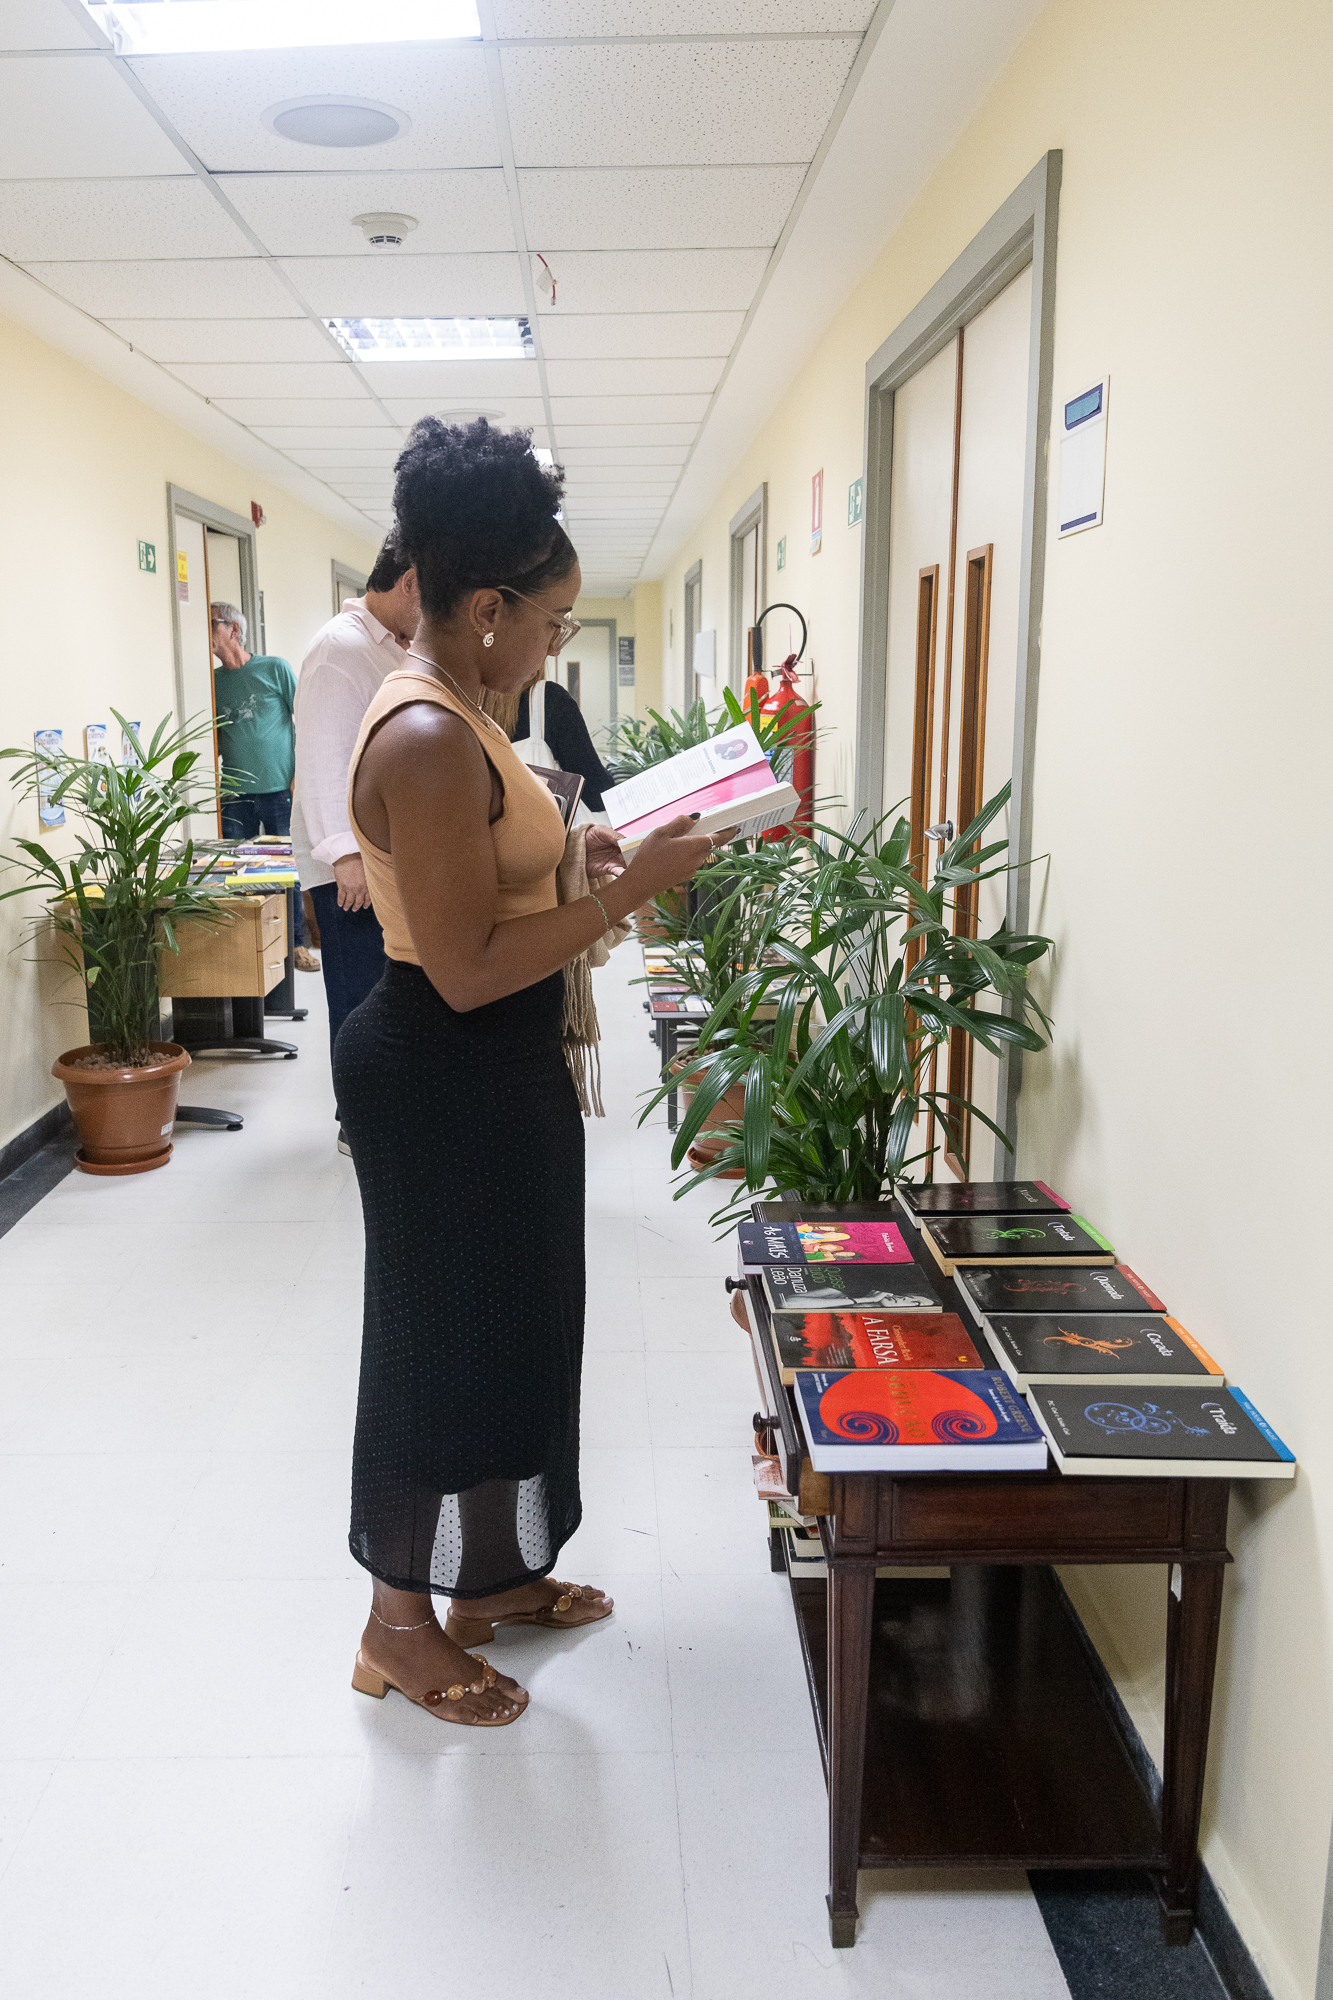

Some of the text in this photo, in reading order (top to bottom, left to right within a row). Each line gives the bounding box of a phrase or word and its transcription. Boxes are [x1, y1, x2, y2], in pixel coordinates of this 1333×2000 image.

[1053, 1224, 1076, 1242] Tentada
[765, 1237, 790, 1260] MAIS
[770, 1267, 788, 1286] Leão
[786, 1267, 808, 1295] Danuza
[808, 1267, 827, 1284] tudo
[825, 1266, 846, 1291] Quase
[1093, 1275, 1125, 1300] Queimada
[862, 1316, 900, 1366] A FARSA
[885, 1374, 927, 1438] SEDUÇÃO
[991, 1376, 1016, 1404] ROBERT
[1008, 1405, 1034, 1433] GREENE
[1209, 1408, 1238, 1435] Traída
